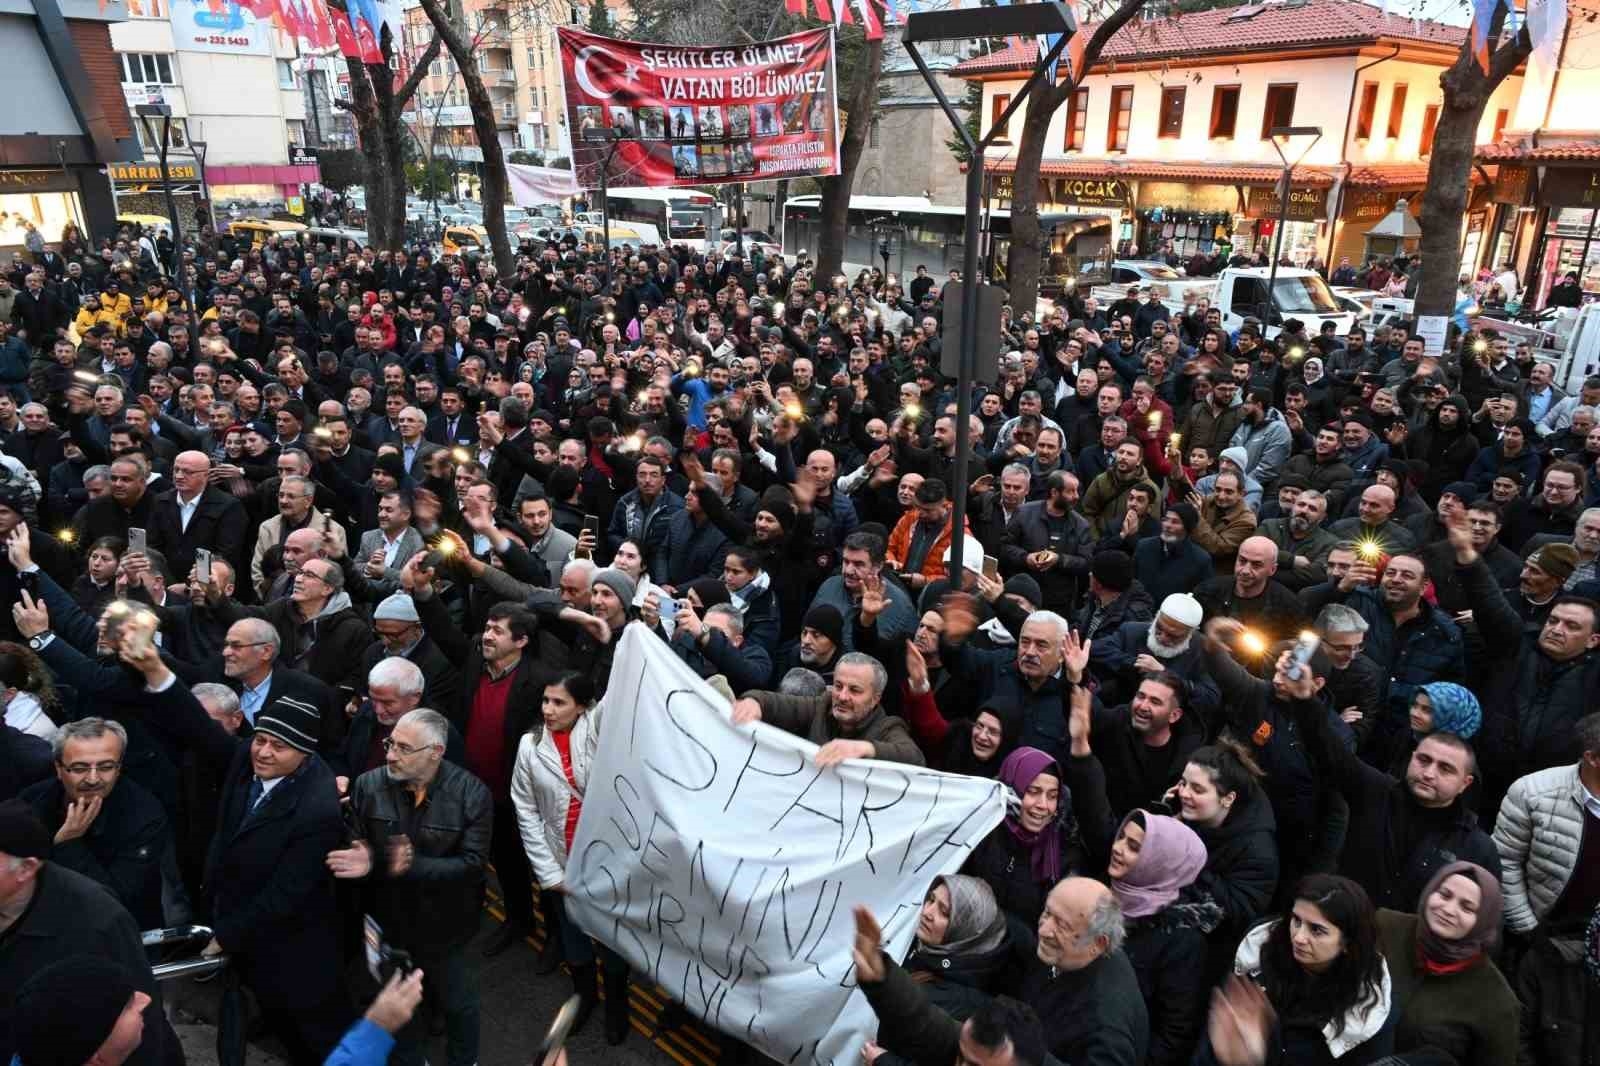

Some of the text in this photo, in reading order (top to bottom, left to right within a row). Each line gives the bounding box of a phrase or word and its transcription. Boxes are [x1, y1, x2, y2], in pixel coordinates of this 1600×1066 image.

[209, 35, 226, 44] 232
[228, 36, 249, 46] 5433
[640, 42, 805, 72] ŞEHİTLER ÖLMEZ
[660, 71, 826, 100] VATAN BÖLÜNMEZ
[111, 166, 195, 179] MARRAESH
[630, 658, 1000, 875] ISPARTA
